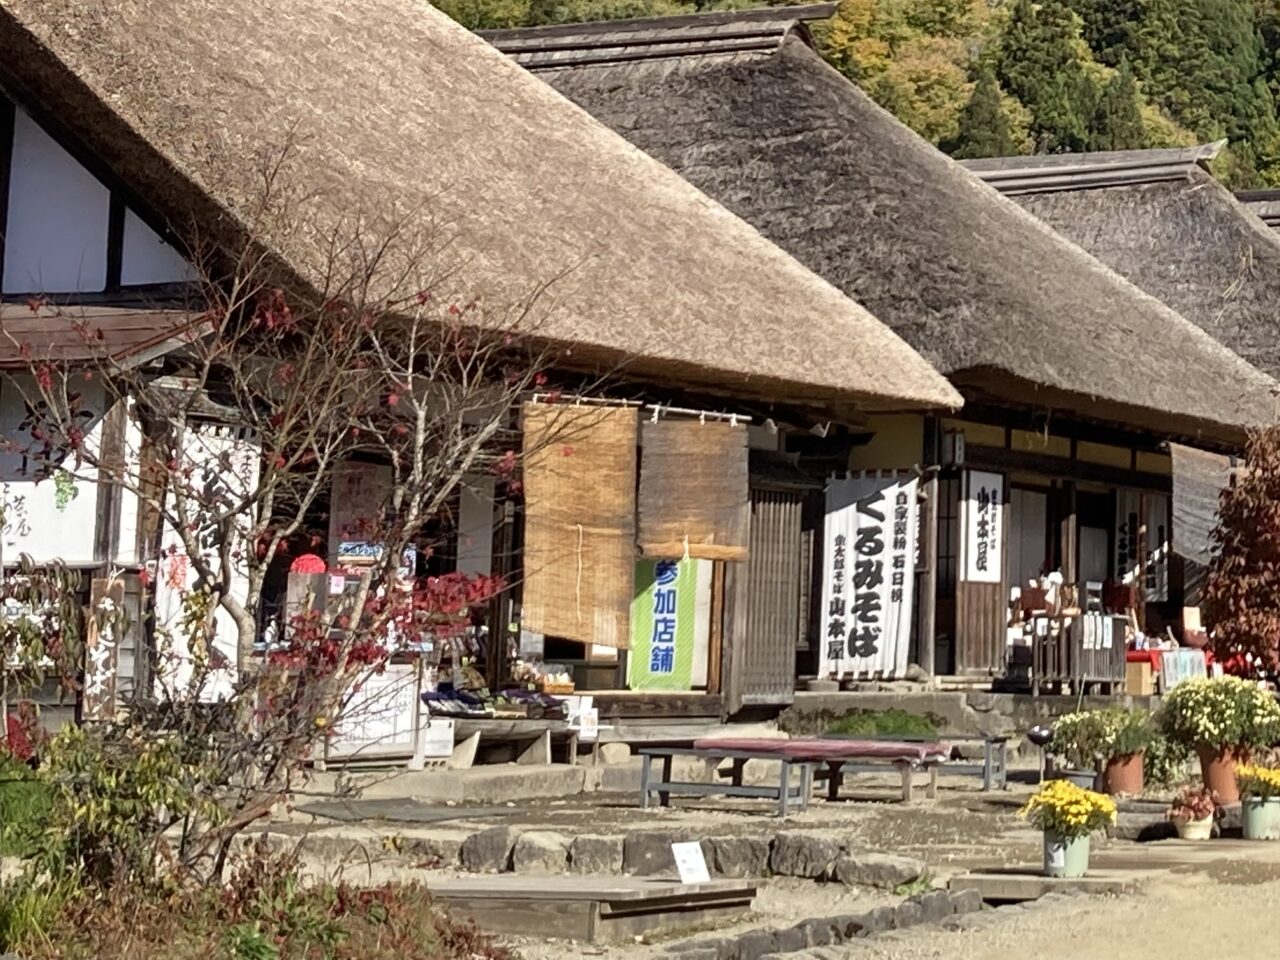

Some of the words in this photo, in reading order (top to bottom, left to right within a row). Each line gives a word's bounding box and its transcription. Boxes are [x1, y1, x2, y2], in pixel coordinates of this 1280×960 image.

[650, 559, 679, 673] 参加店舗
[847, 490, 886, 658] くるみそば
